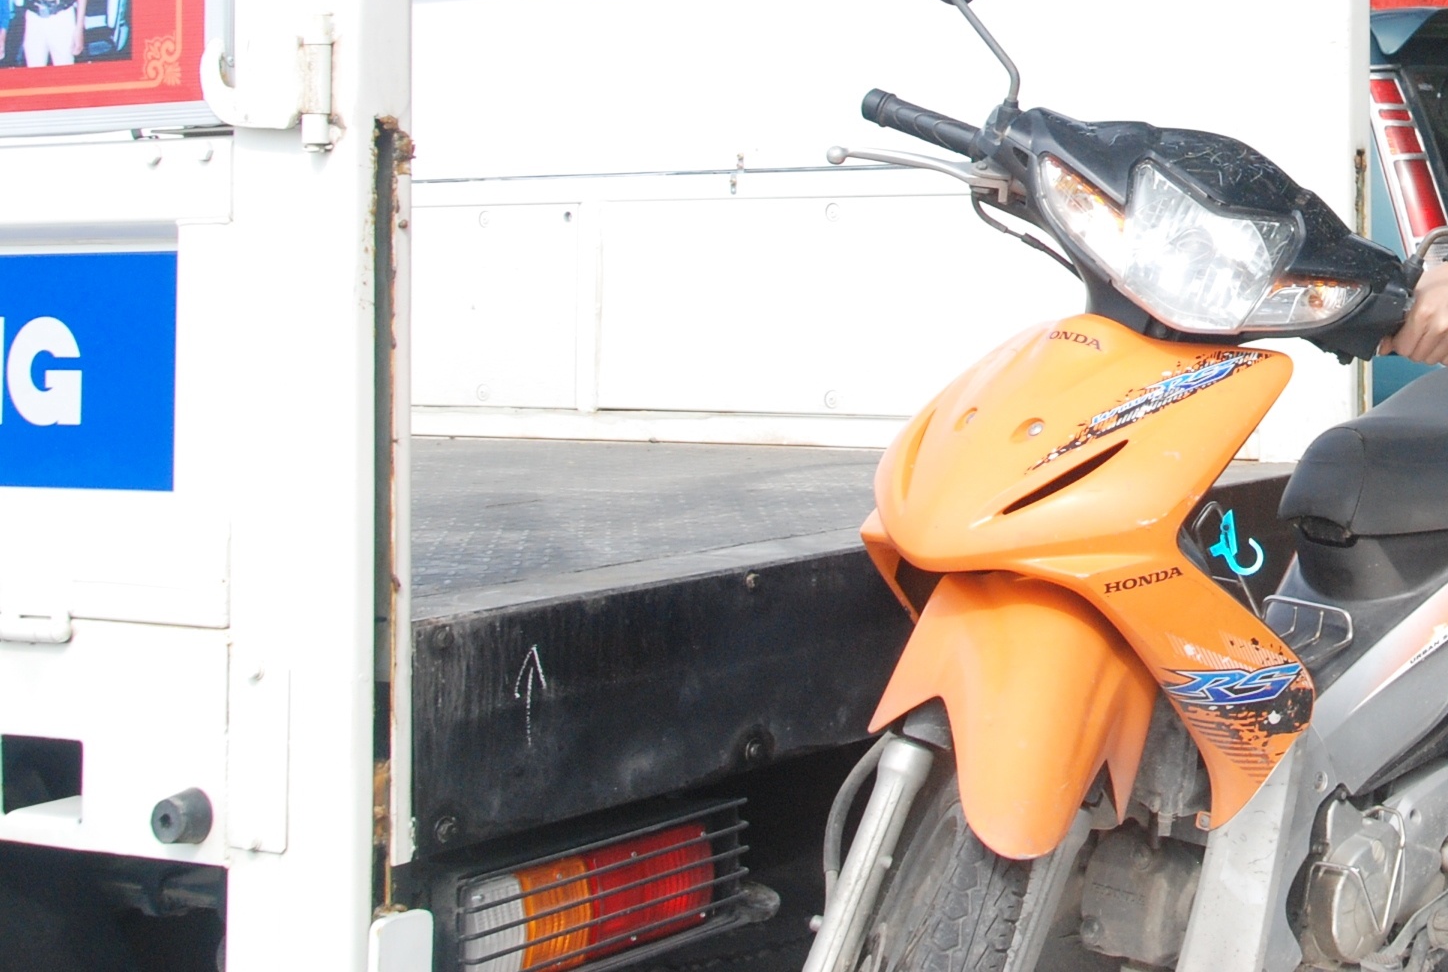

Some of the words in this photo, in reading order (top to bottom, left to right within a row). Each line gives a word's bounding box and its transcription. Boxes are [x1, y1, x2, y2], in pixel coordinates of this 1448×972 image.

[1048, 331, 1103, 352] ONDA
[0, 315, 83, 426] G
[1103, 566, 1184, 595] HONDA
[1409, 640, 1440, 665] URBAN
[1160, 661, 1304, 706] RS
